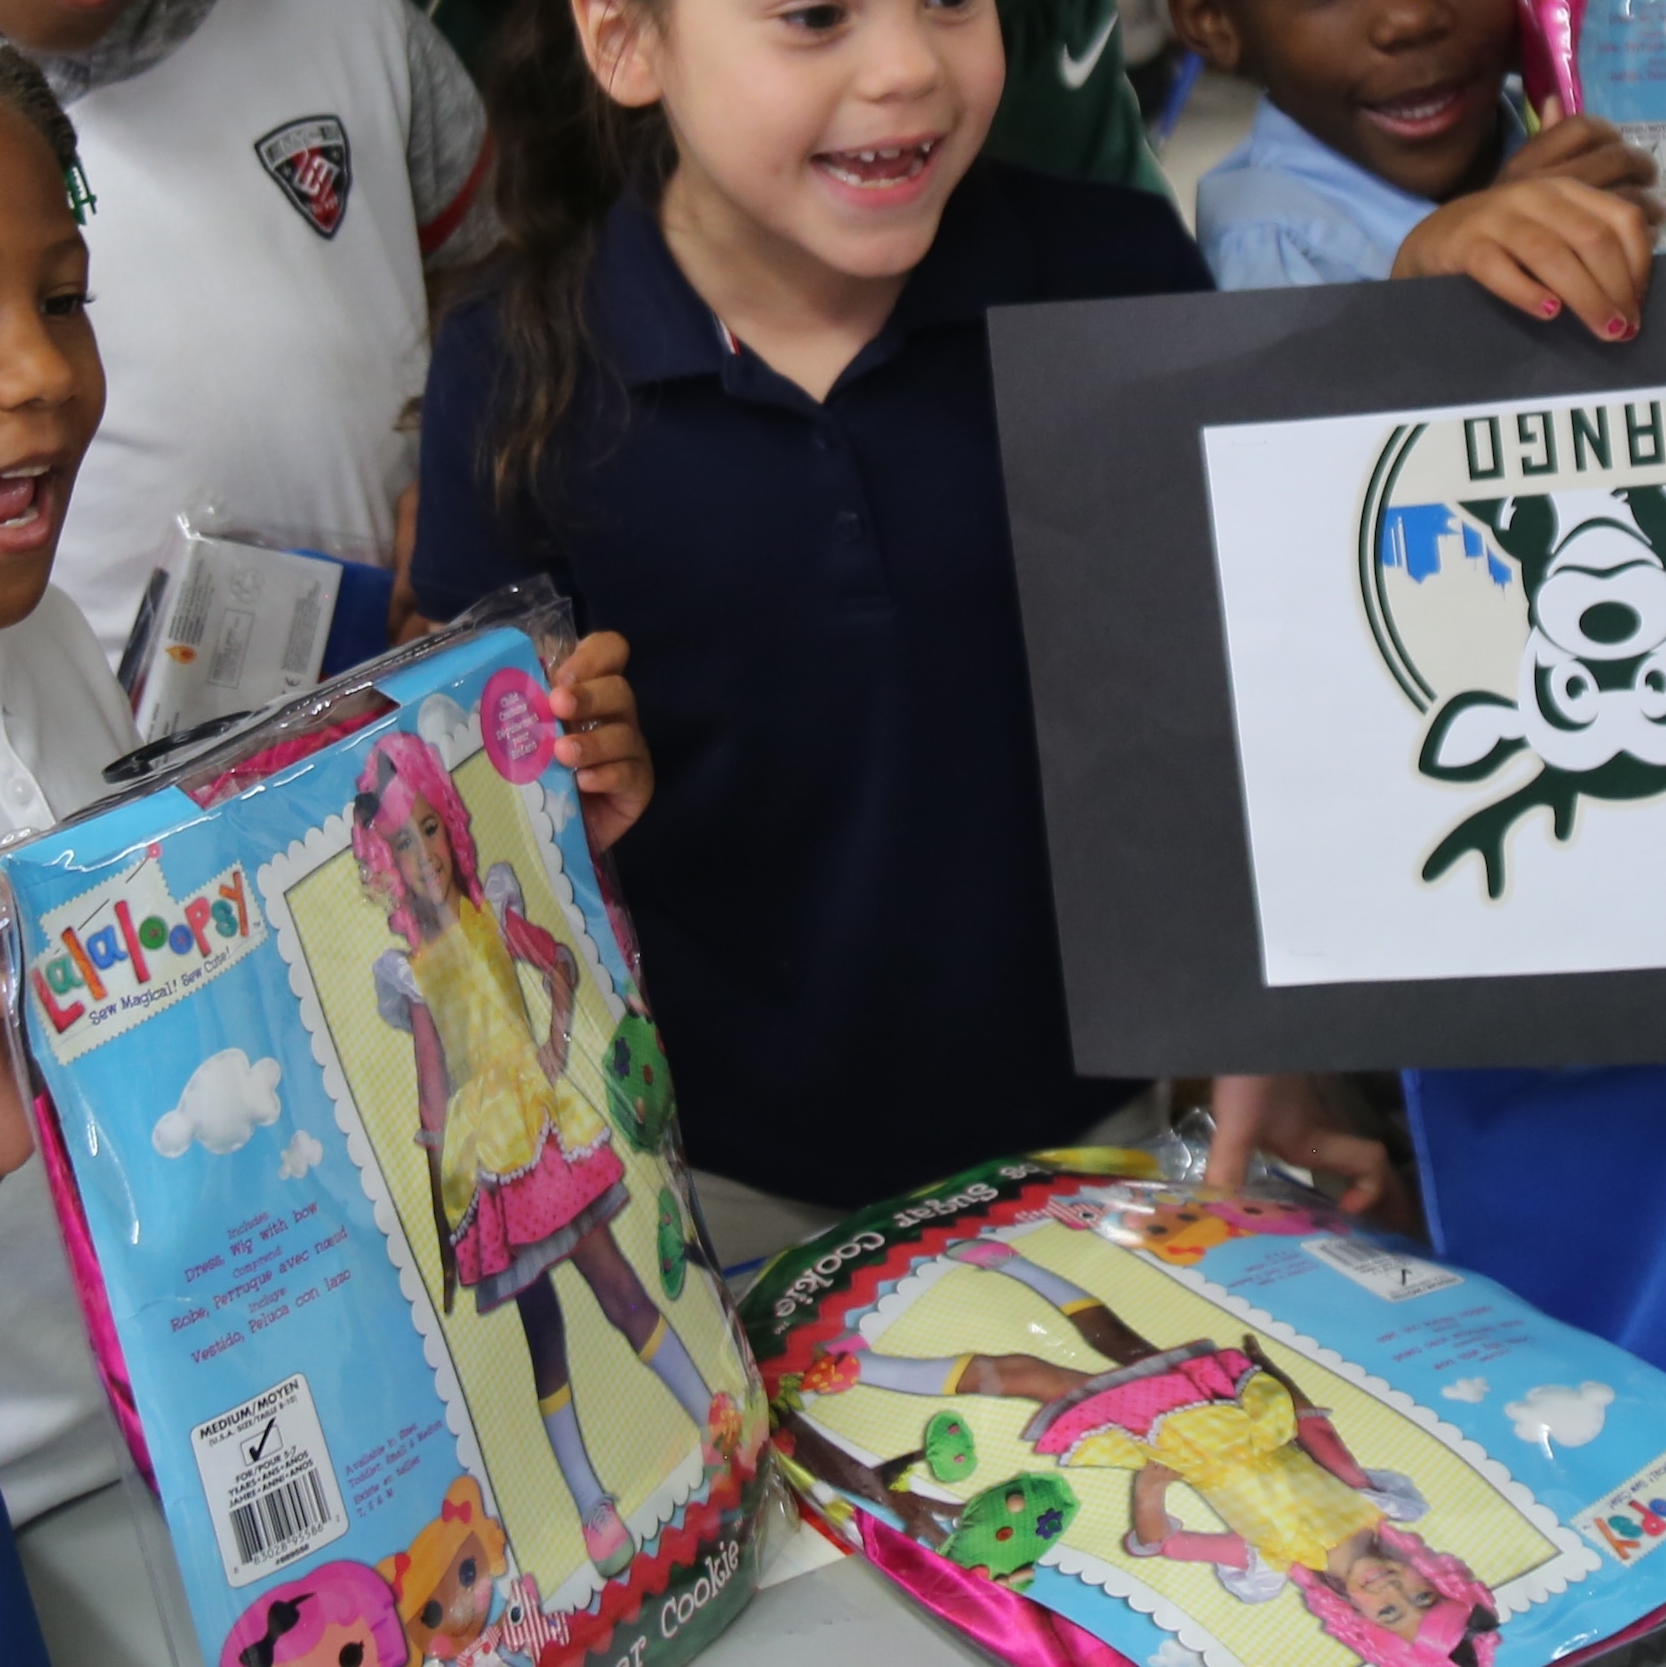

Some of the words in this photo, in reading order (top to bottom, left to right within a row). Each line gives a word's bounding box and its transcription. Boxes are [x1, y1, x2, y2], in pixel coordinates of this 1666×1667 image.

[89, 1001, 117, 1025] Sew
[120, 980, 178, 1010] Magical!
[181, 969, 203, 987] Sew
[204, 946, 232, 973] Cute!
[184, 1254, 225, 1283] Dress,
[230, 1237, 253, 1256] Wig
[259, 1218, 289, 1241] with
[292, 1201, 318, 1223] bow
[892, 1183, 999, 1228] Sugar
[170, 1306, 210, 1332] Robe,
[212, 1270, 273, 1309] Perruque
[278, 1249, 310, 1274] avec
[774, 1232, 885, 1317] Cookie
[191, 1331, 245, 1364] Vestido,
[248, 1303, 290, 1334] Peluca
[295, 1286, 320, 1308] con
[324, 1269, 351, 1292] lazo
[199, 1378, 300, 1440] MEDIUM/MOYEN
[661, 1540, 739, 1639] Cookie
